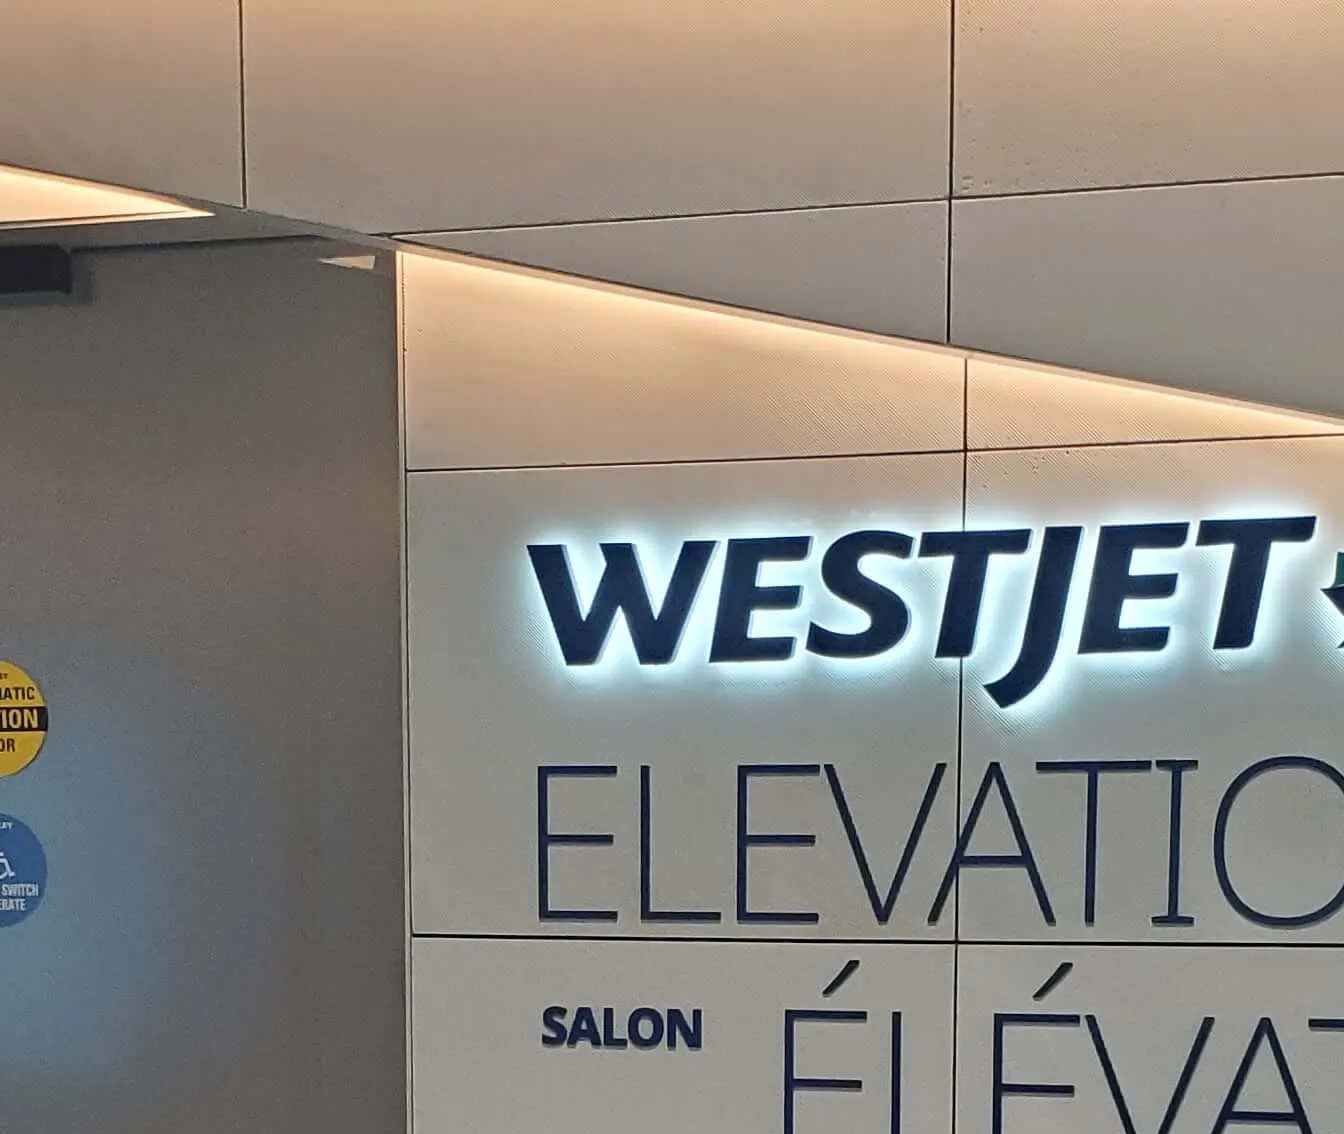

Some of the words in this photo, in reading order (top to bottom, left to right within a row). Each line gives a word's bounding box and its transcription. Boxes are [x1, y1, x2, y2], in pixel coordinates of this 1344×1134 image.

[527, 516, 1316, 708] WESTJET
[1, 883, 39, 898] SWITCH
[541, 1005, 703, 1051] SALON
